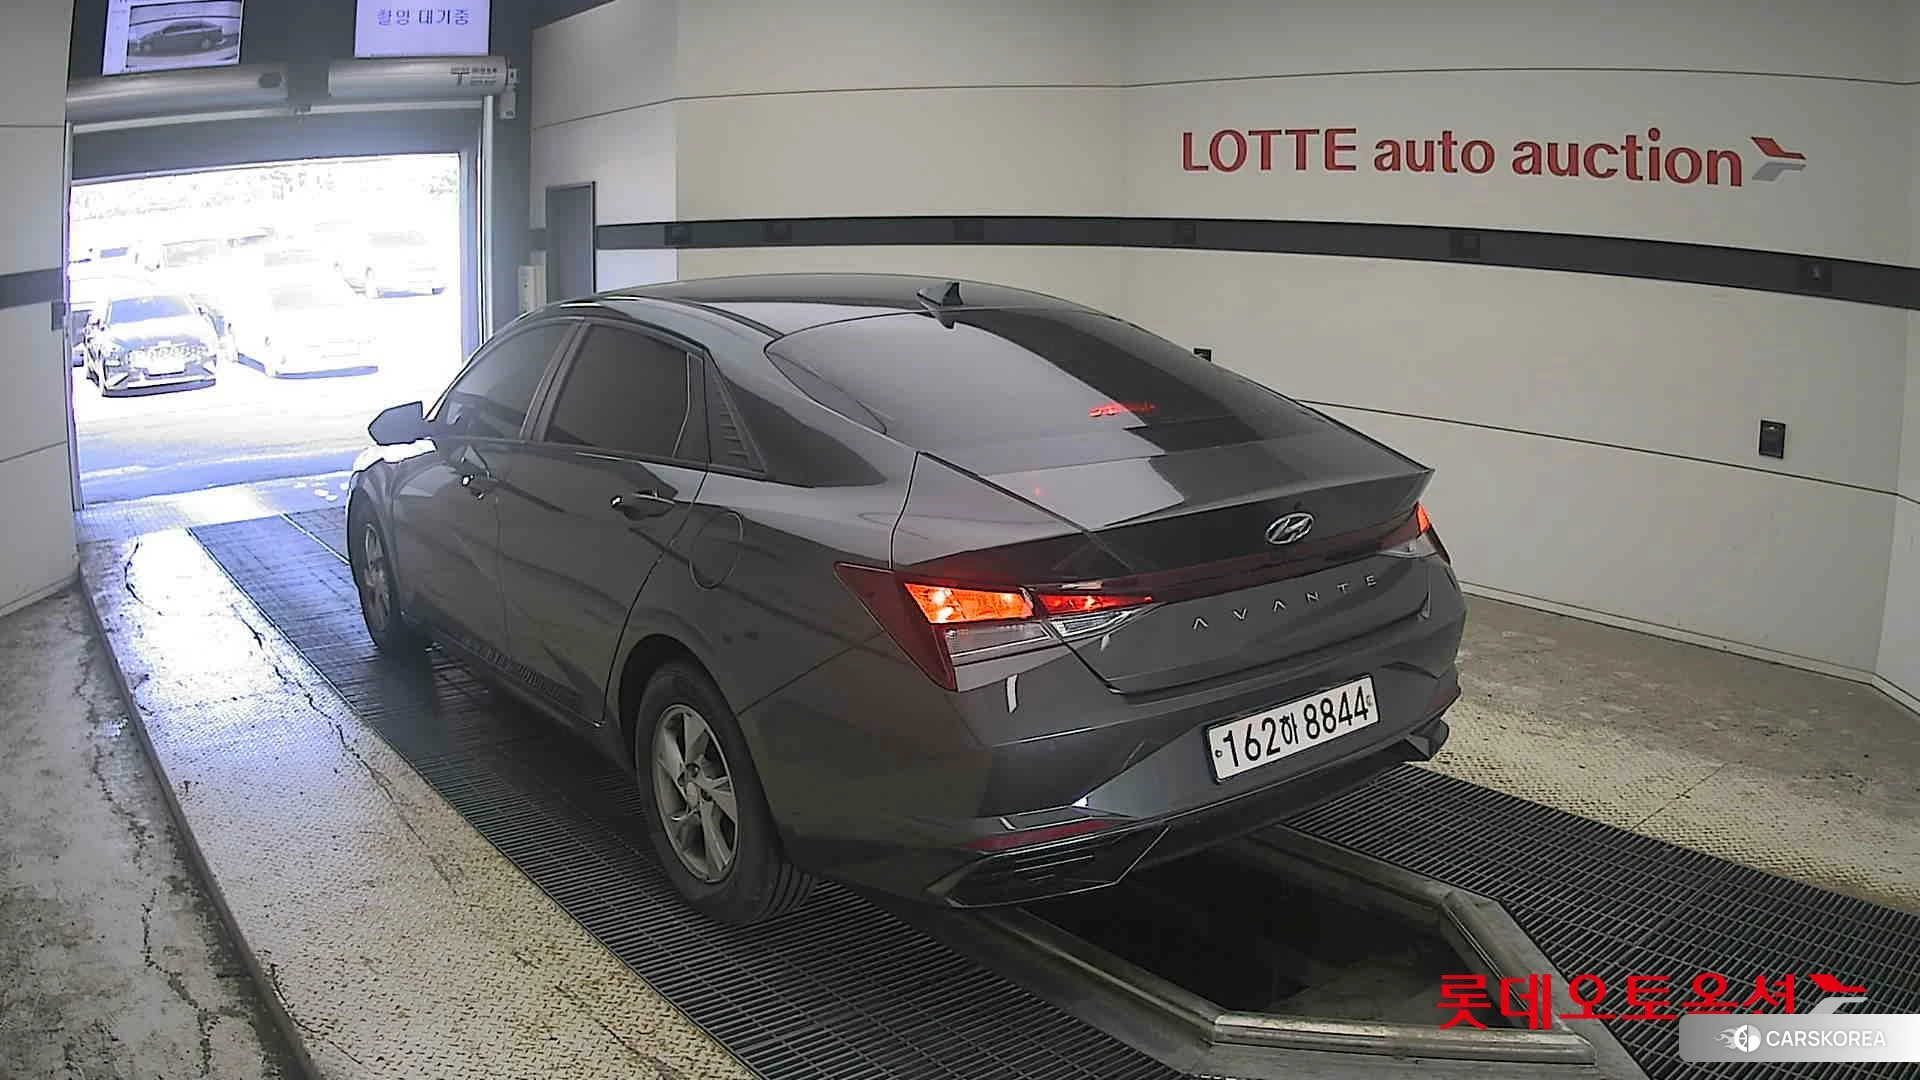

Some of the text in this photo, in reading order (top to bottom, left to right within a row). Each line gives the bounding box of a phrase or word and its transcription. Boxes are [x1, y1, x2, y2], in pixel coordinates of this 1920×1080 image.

[418, 8, 470, 26] 대기중
[1182, 128, 1743, 186] LOTTE auto auction
[1191, 575, 1379, 632] AVANTE
